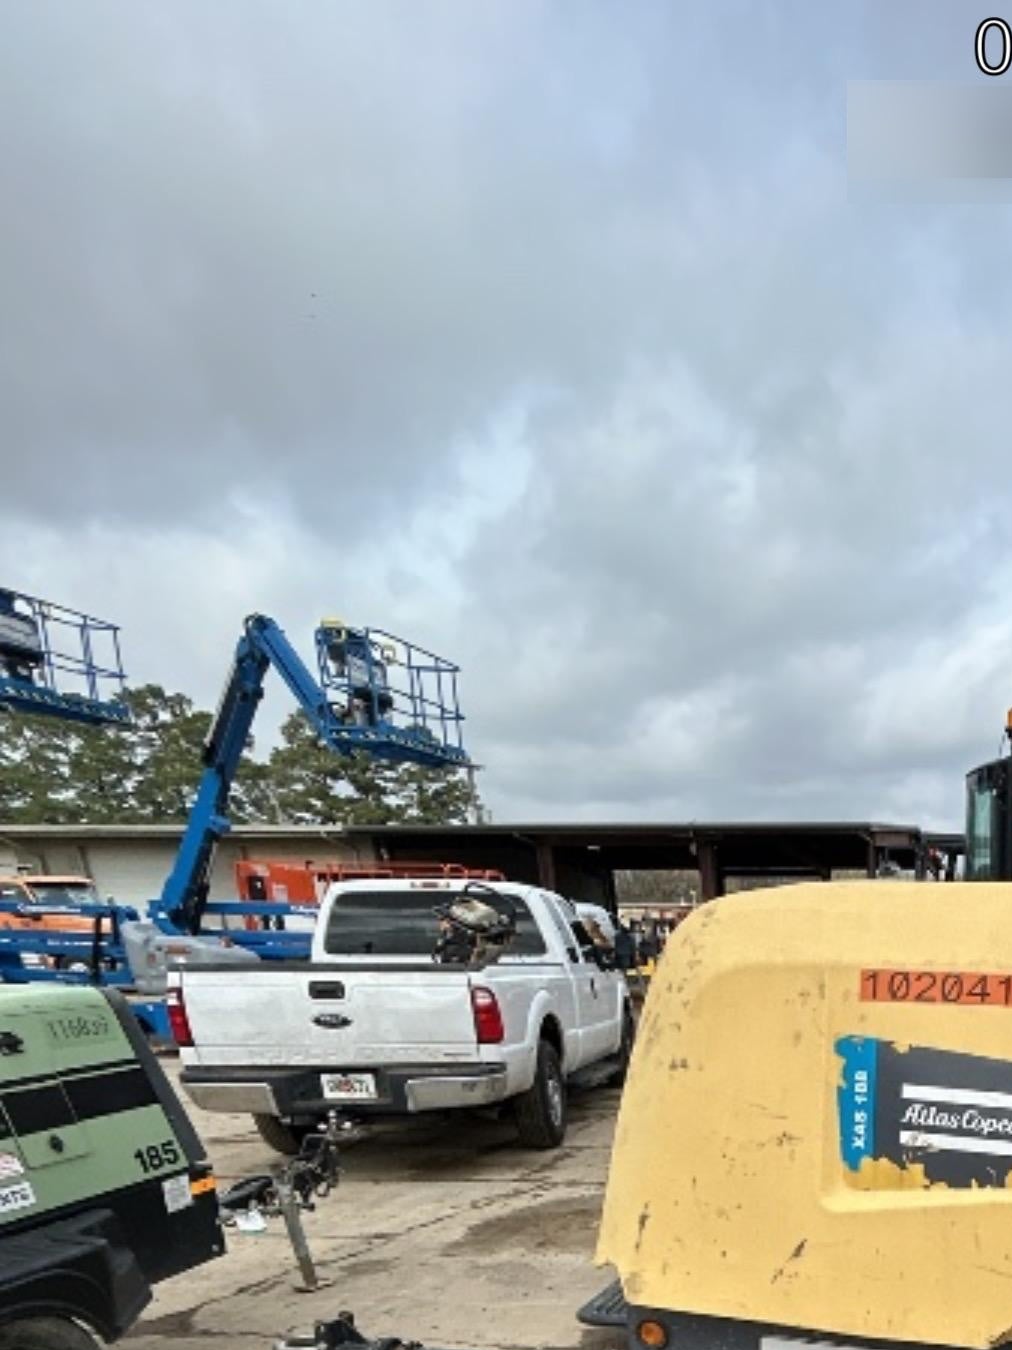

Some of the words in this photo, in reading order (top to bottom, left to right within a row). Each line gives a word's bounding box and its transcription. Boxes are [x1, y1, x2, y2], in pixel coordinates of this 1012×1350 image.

[864, 972, 1012, 1005] 102041
[901, 1103, 960, 1129] Atlas
[134, 1140, 180, 1173] 185
